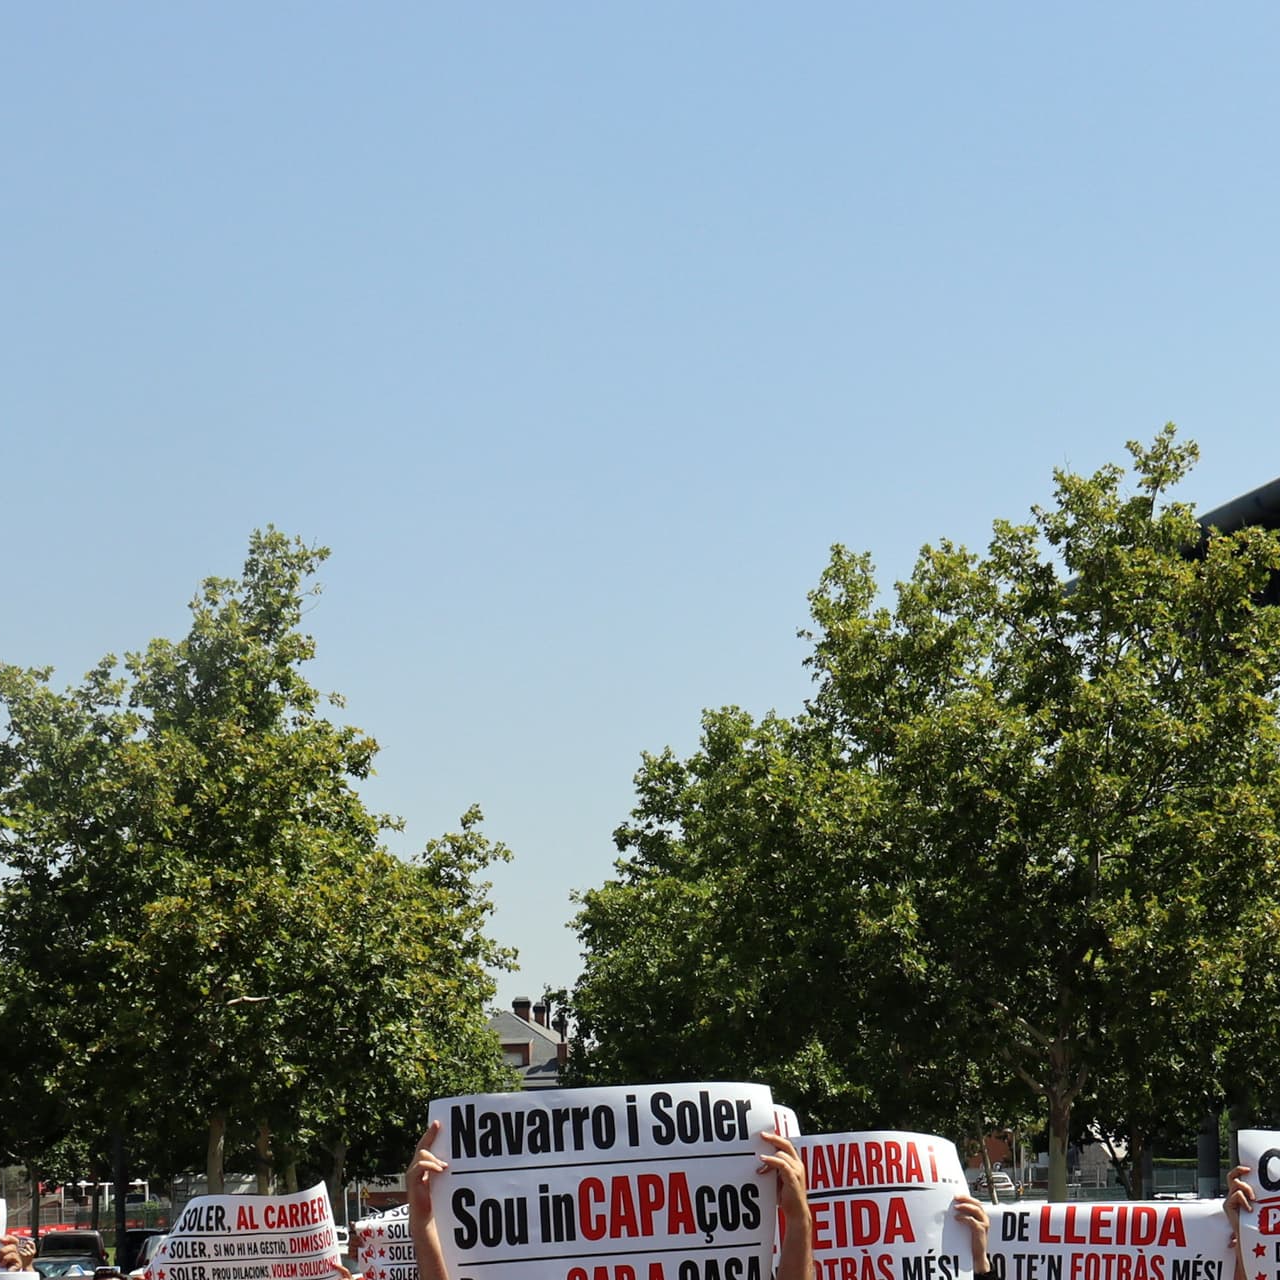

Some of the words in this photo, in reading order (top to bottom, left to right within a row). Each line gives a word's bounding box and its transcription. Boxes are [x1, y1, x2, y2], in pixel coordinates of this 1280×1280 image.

[451, 1104, 615, 1159] Navarro
[626, 1095, 640, 1147] i
[651, 1091, 751, 1143] Soler
[452, 1188, 527, 1249] Sou
[539, 1172, 760, 1243] inCAPAços
[1001, 1211, 1030, 1241] DE
[1039, 1206, 1186, 1247] LLEIDA
